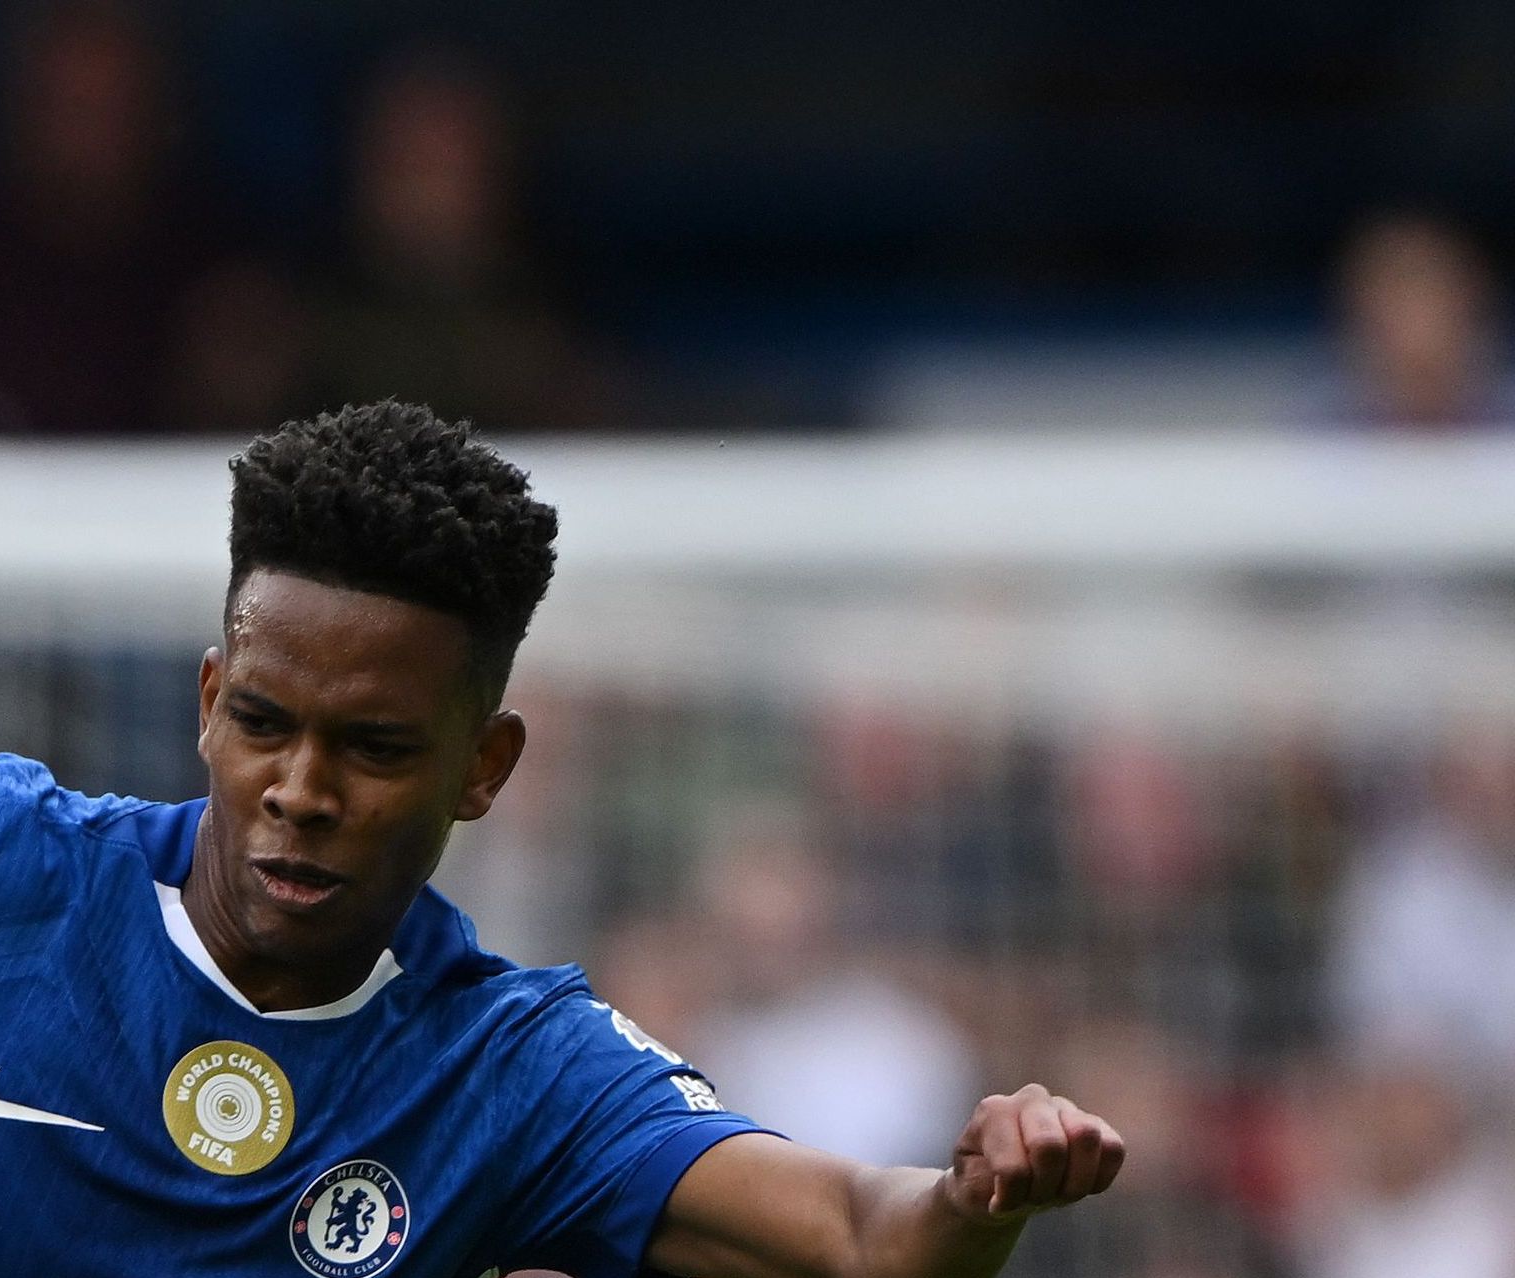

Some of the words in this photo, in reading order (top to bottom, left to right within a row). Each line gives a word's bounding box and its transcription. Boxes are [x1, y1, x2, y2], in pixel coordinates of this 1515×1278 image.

[176, 1053, 223, 1102] WORLD
[227, 1053, 283, 1143] CHAMPIONS
[188, 1132, 236, 1167] FIFA
[324, 1166, 392, 1192] CHELSEA
[302, 1247, 349, 1277] FOOTBALL
[354, 1256, 381, 1276] CLUB
